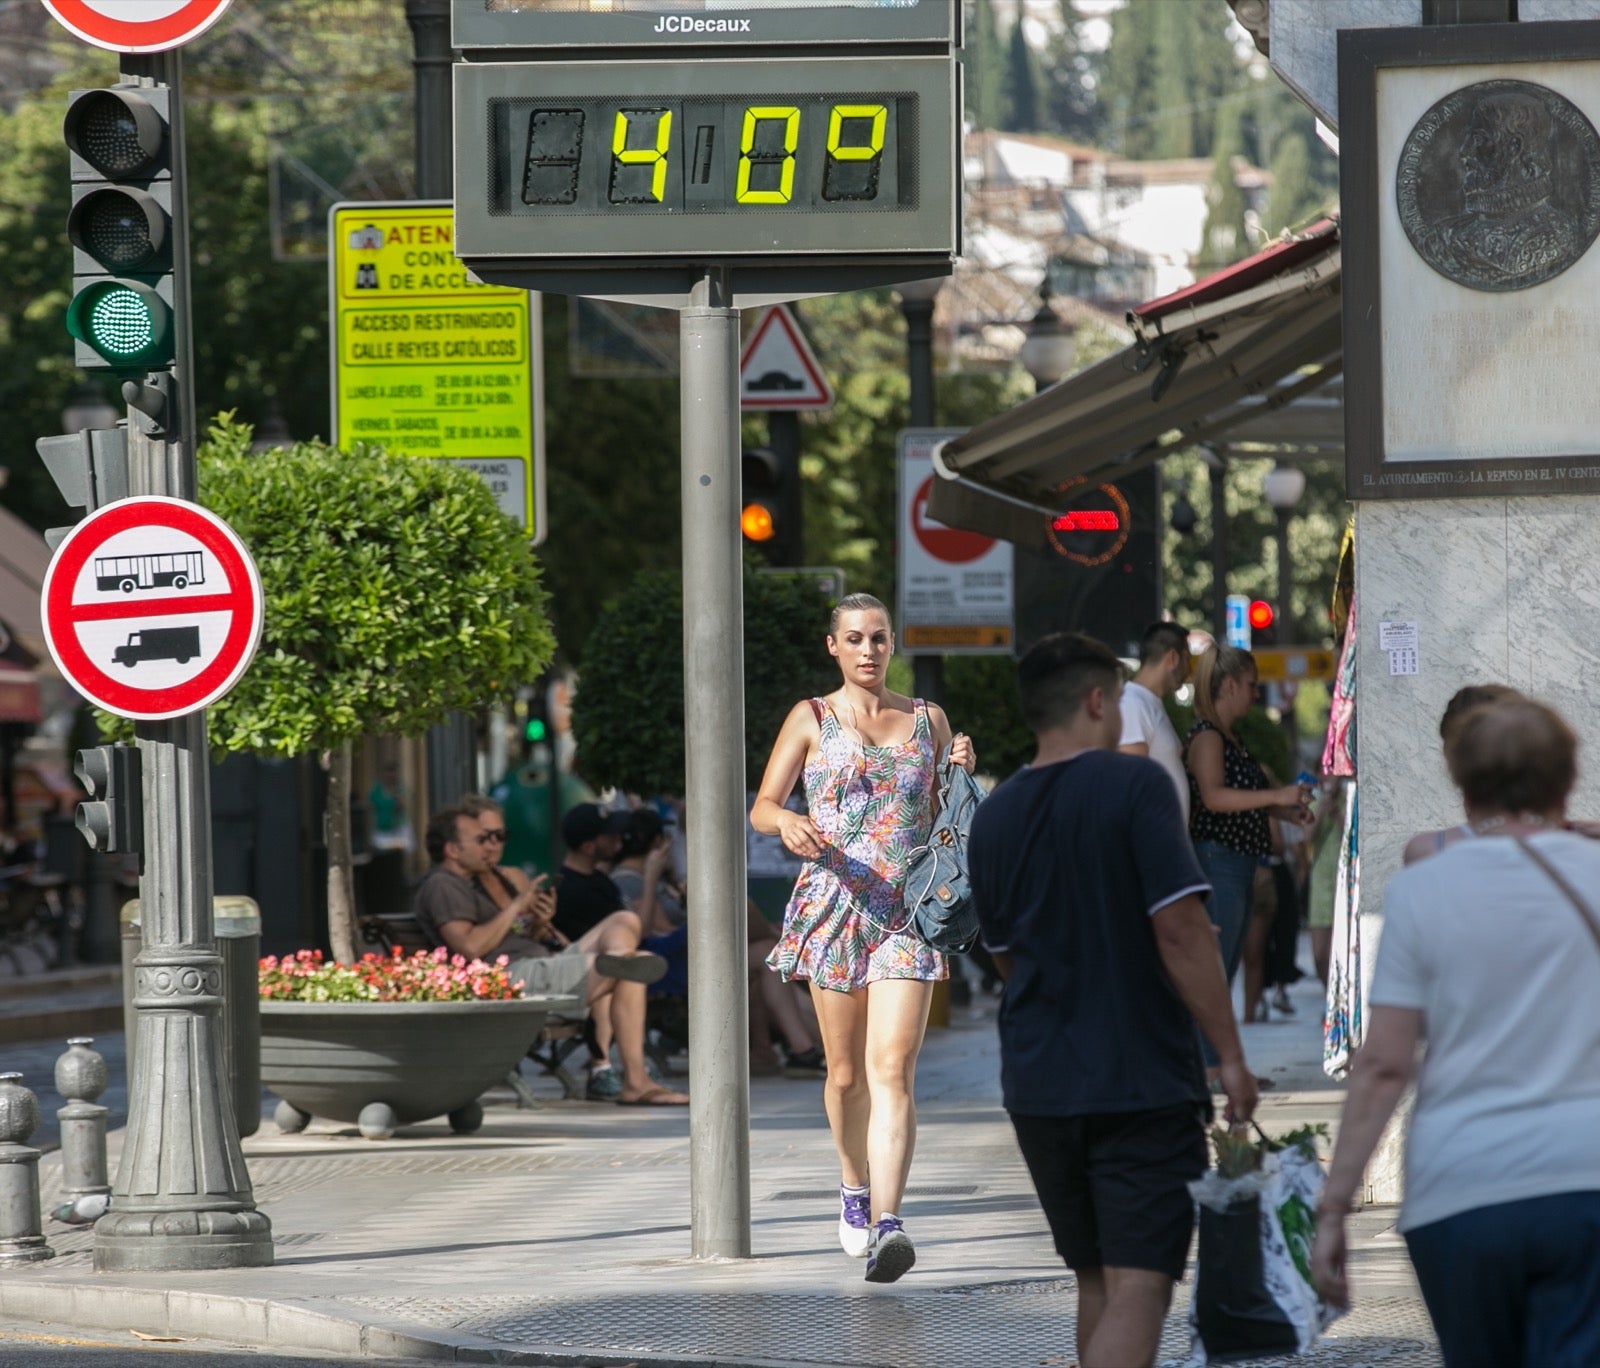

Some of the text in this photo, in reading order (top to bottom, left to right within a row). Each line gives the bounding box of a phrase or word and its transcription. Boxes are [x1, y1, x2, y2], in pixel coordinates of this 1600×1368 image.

[653, 16, 751, 34] JCDecaux
[387, 226, 451, 244] ATEN
[404, 251, 457, 267] CONT
[390, 273, 502, 290] DE ACCE
[351, 311, 516, 330] ACCESO RESTRINGIDO
[351, 342, 393, 359] CALLE
[397, 340, 441, 358] REYES
[1363, 474, 1376, 486] EL
[1378, 471, 1454, 485] AYUNTAMIENTO
[1470, 471, 1484, 483] LA
[1486, 470, 1523, 482] REPUSO
[1524, 469, 1538, 481] EN
[1540, 468, 1553, 480] EL
[1555, 467, 1567, 479] IV
